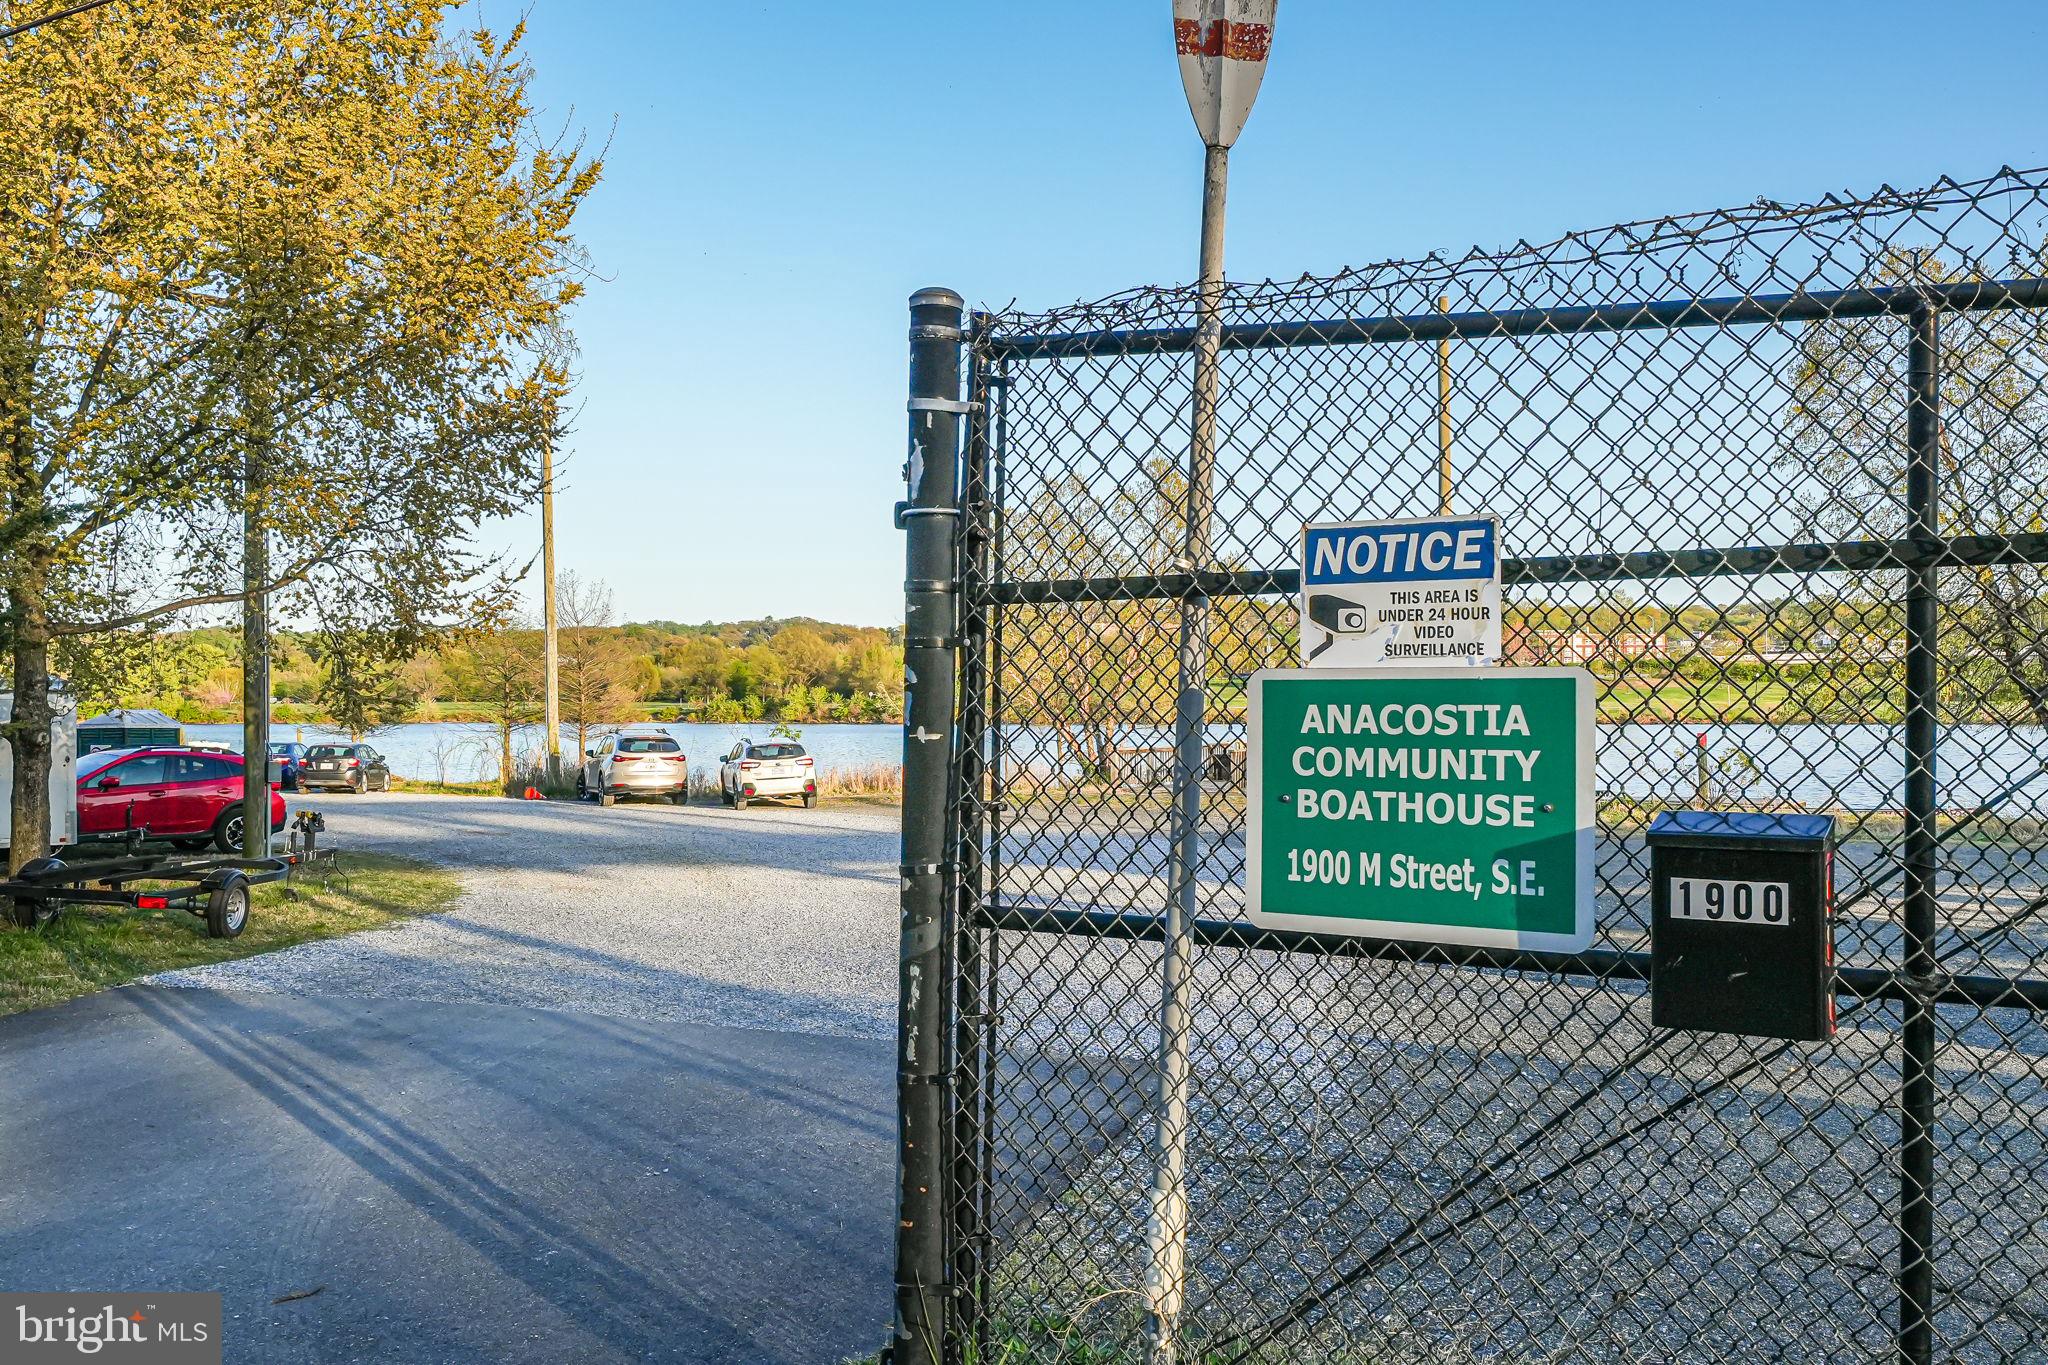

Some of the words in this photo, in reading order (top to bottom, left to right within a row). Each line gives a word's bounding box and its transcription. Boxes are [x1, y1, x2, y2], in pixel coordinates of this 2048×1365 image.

[1313, 529, 1486, 575] NOTICE
[1390, 591, 1420, 605] THIS
[1424, 590, 1460, 603] AREA
[1465, 589, 1478, 602] IS
[1378, 609, 1423, 622] UNDER
[1429, 608, 1445, 621] 24
[1451, 607, 1490, 620] HOUR
[1385, 642, 1485, 656] SURVEILLANCE
[1414, 626, 1454, 639] VIDEO
[1300, 704, 1530, 736] ANACOSTIA
[1291, 747, 1541, 782] COMMUNITY
[1296, 789, 1535, 827] BOATHOUSE
[1287, 849, 1351, 884] 1900
[1359, 852, 1381, 887] M
[1389, 854, 1482, 900] Street,
[1491, 859, 1545, 896] S.E.
[1679, 881, 1783, 922] 1900
